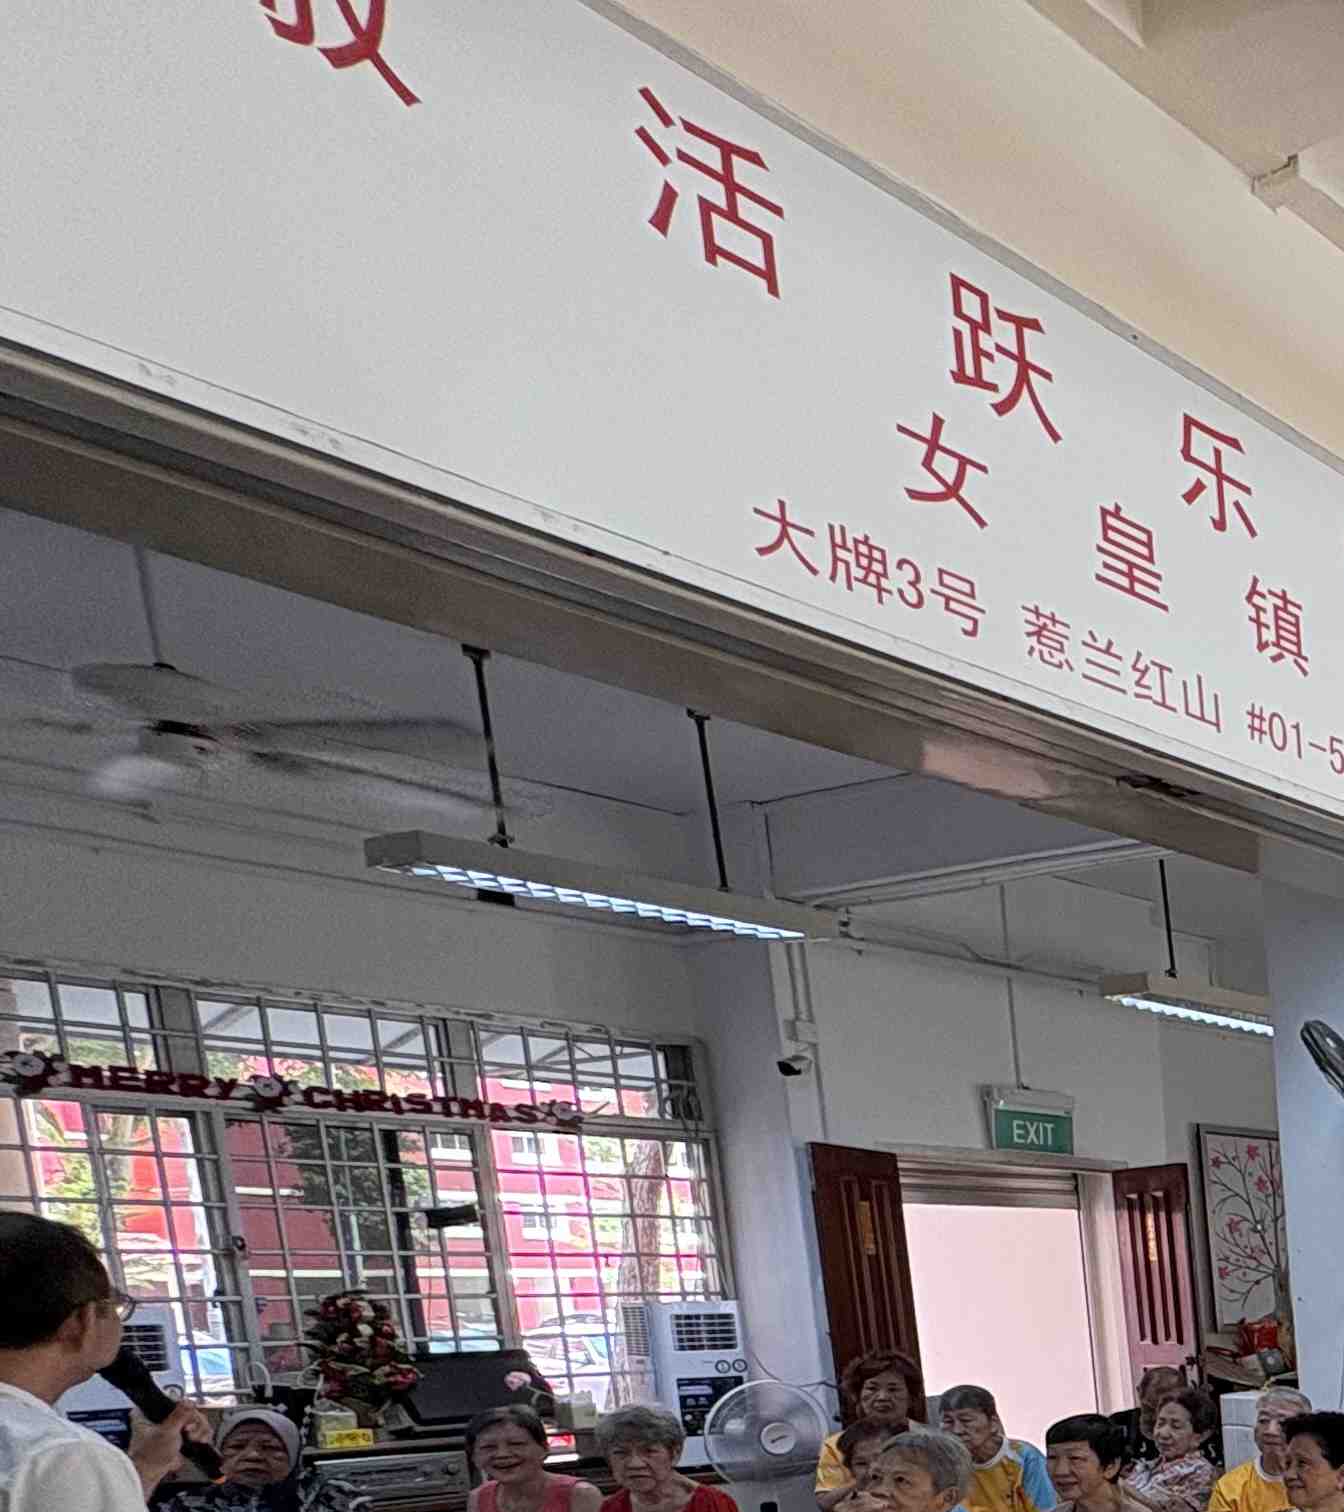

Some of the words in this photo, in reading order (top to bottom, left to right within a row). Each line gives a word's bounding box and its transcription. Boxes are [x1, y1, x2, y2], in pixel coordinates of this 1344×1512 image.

[752, 498, 987, 639] 大牌3号
[1020, 602, 1222, 734] 惹兰红山
[896, 411, 1310, 678] 女皇镇
[70, 1063, 237, 1101] MERRY
[302, 1085, 541, 1126] CHRISTMAS
[1012, 1119, 1056, 1146] EXIT
